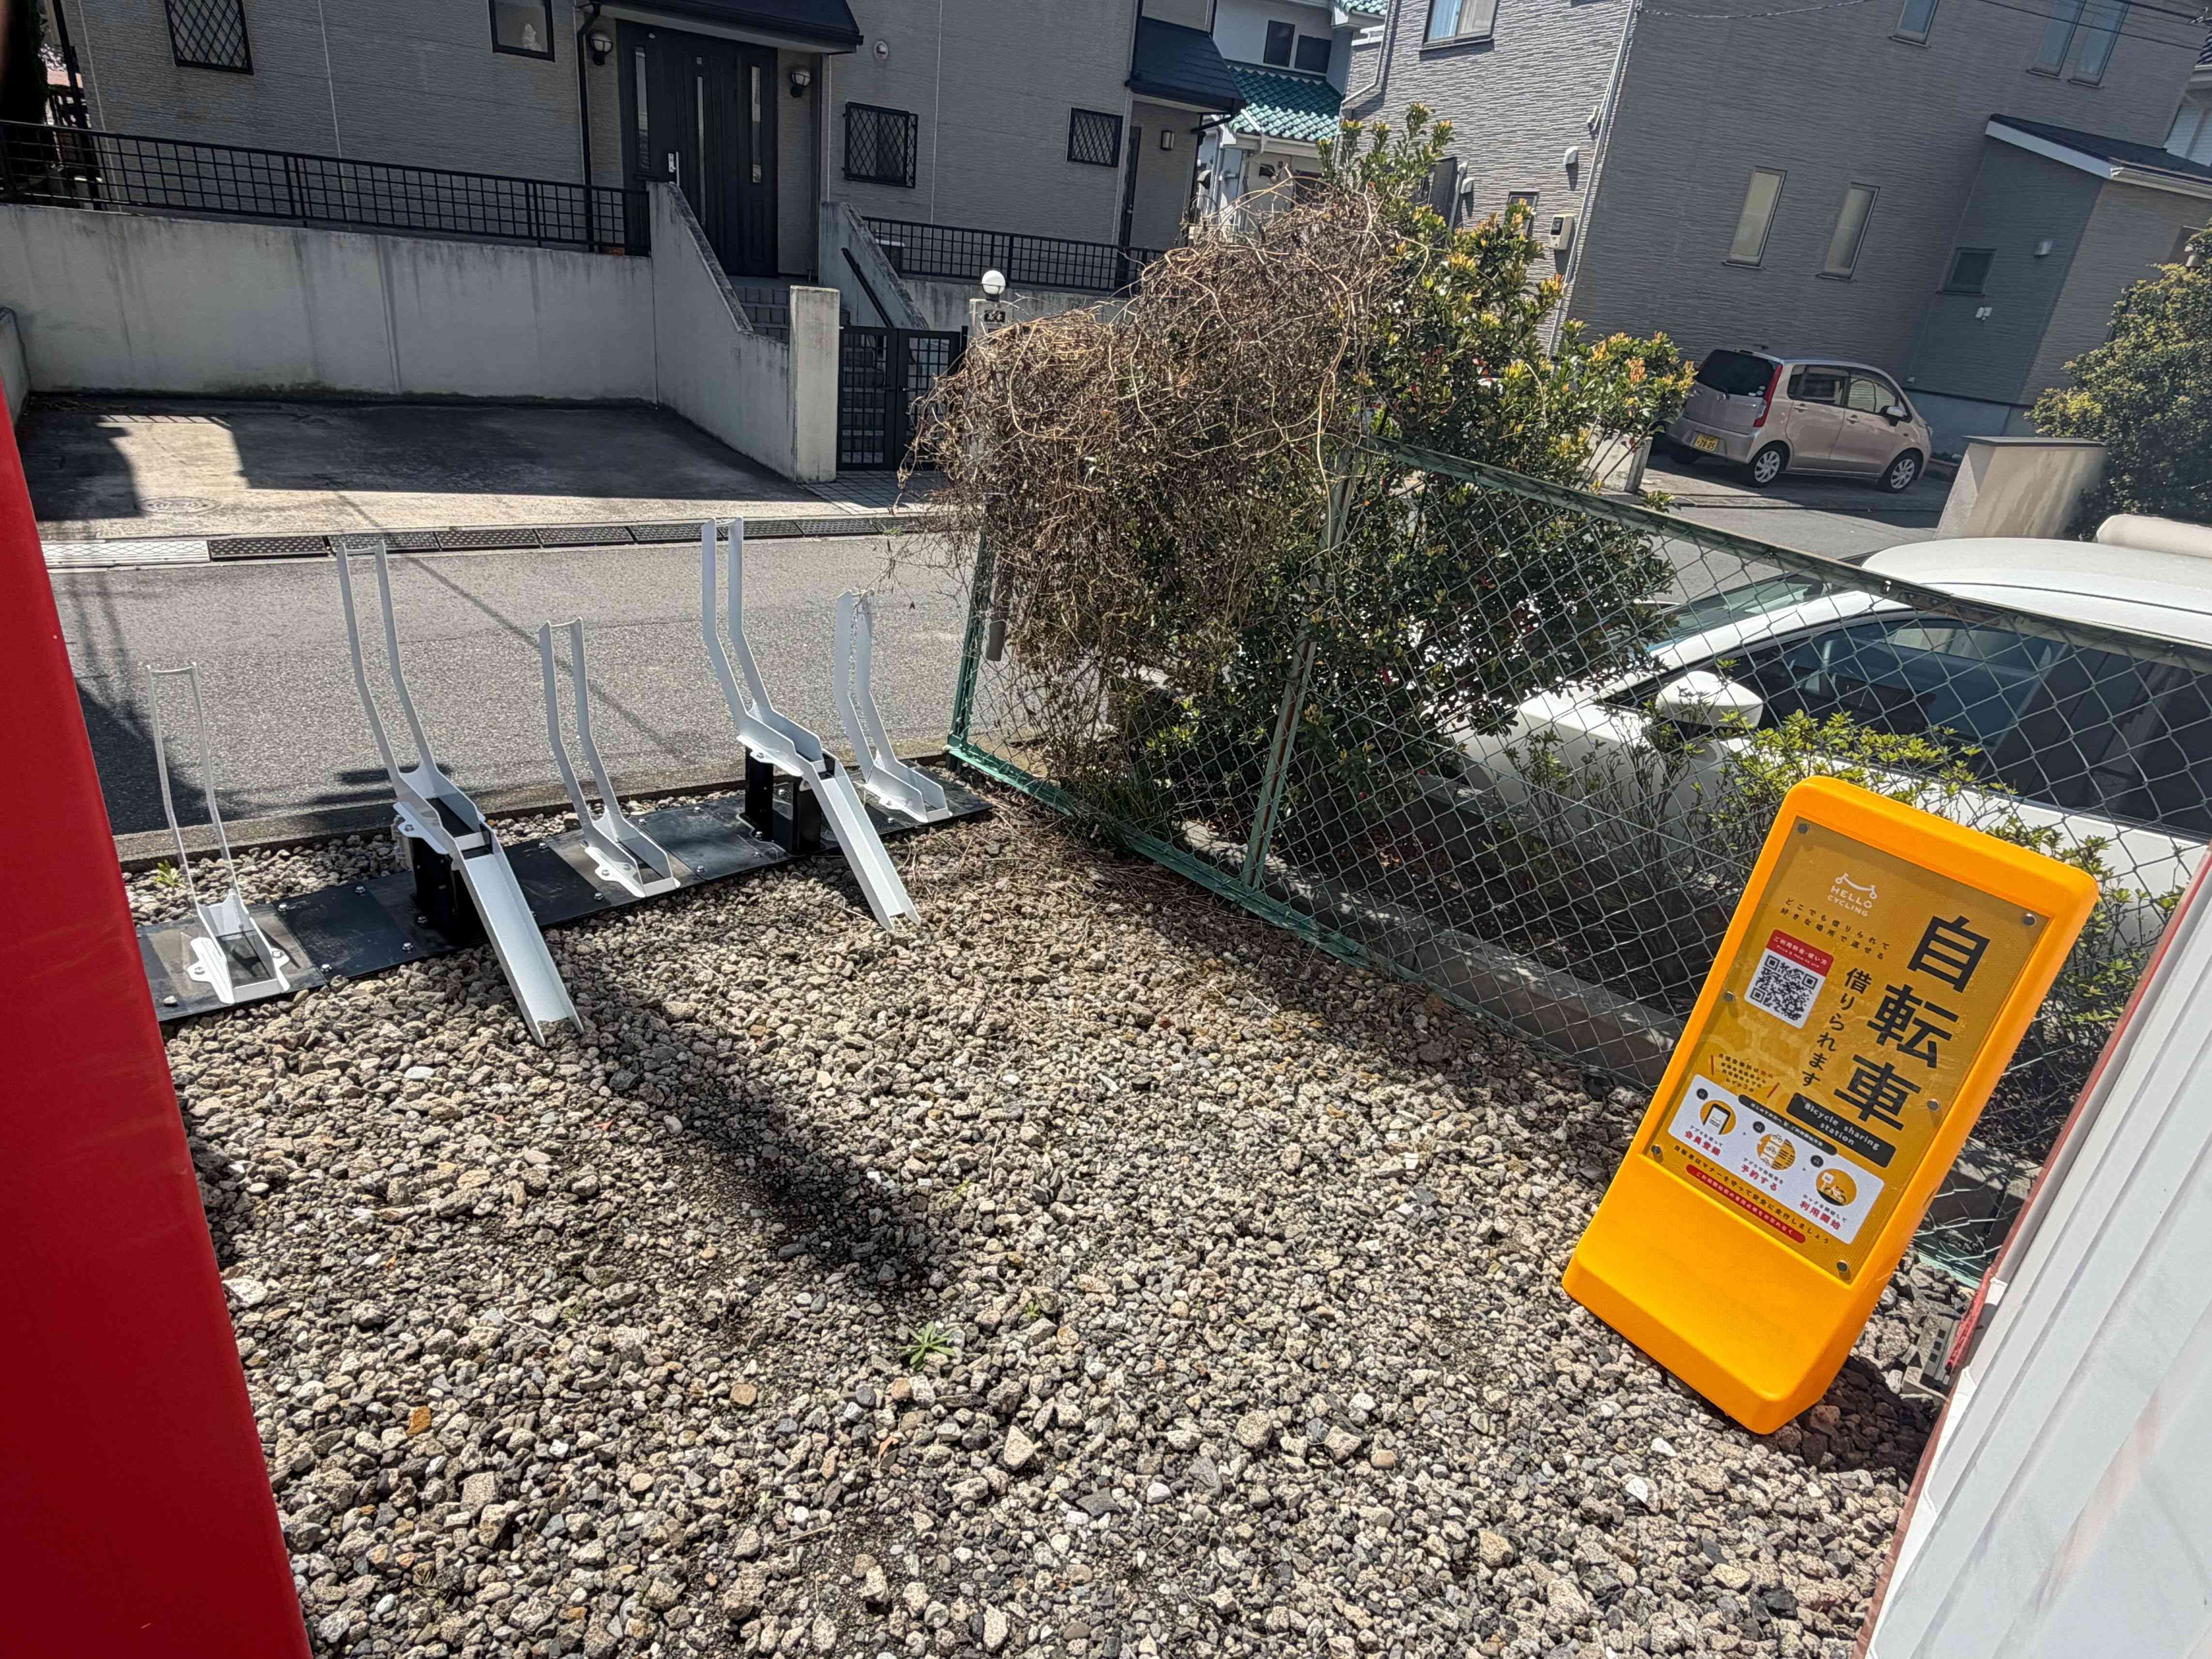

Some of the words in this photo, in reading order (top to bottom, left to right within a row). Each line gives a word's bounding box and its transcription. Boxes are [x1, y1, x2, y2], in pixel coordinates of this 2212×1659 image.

[1826, 894, 1869, 918] CYCLING
[1830, 885, 1874, 909] HELLO
[1780, 907, 1885, 960] 好きな場所で返せる
[1785, 897, 1890, 950] どこでも借りられて
[1803, 967, 1872, 1087] 借りられます
[1834, 915, 1989, 1132] 自転車
[1803, 1102, 1839, 1128] Bicycle
[1842, 1124, 1881, 1151] sharing
[1819, 1122, 1855, 1146] station
[1740, 1163, 1778, 1191] 予約する
[1799, 1200, 1841, 1230] 利用開始
